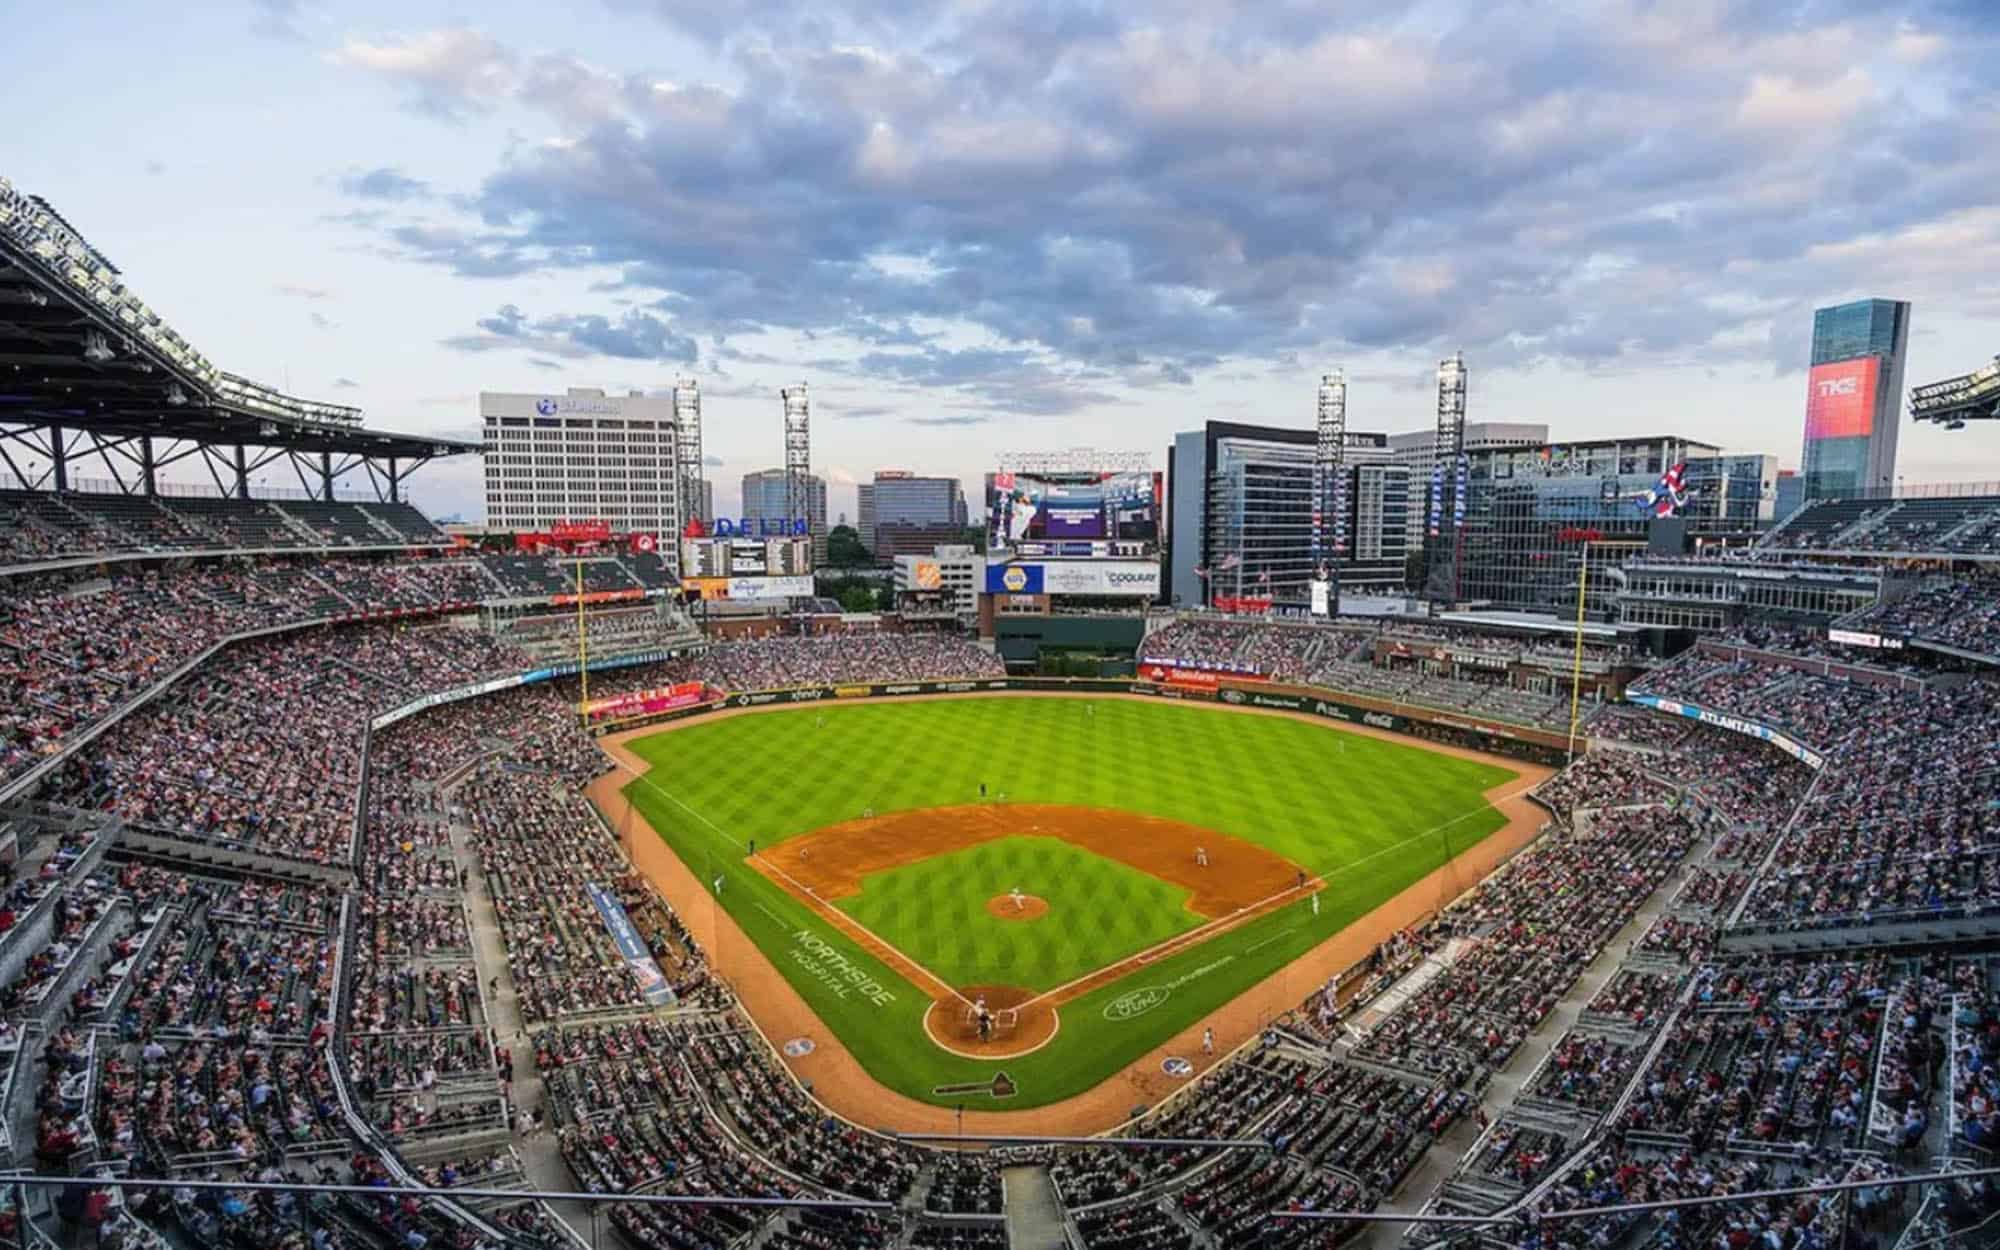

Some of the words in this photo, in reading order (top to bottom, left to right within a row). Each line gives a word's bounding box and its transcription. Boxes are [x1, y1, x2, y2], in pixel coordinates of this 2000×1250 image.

[717, 517, 808, 536] DELTA
[788, 950, 850, 999] HOSPITAL
[792, 929, 897, 1007] NORTHSIDE
[1116, 990, 1158, 1017] Ford
